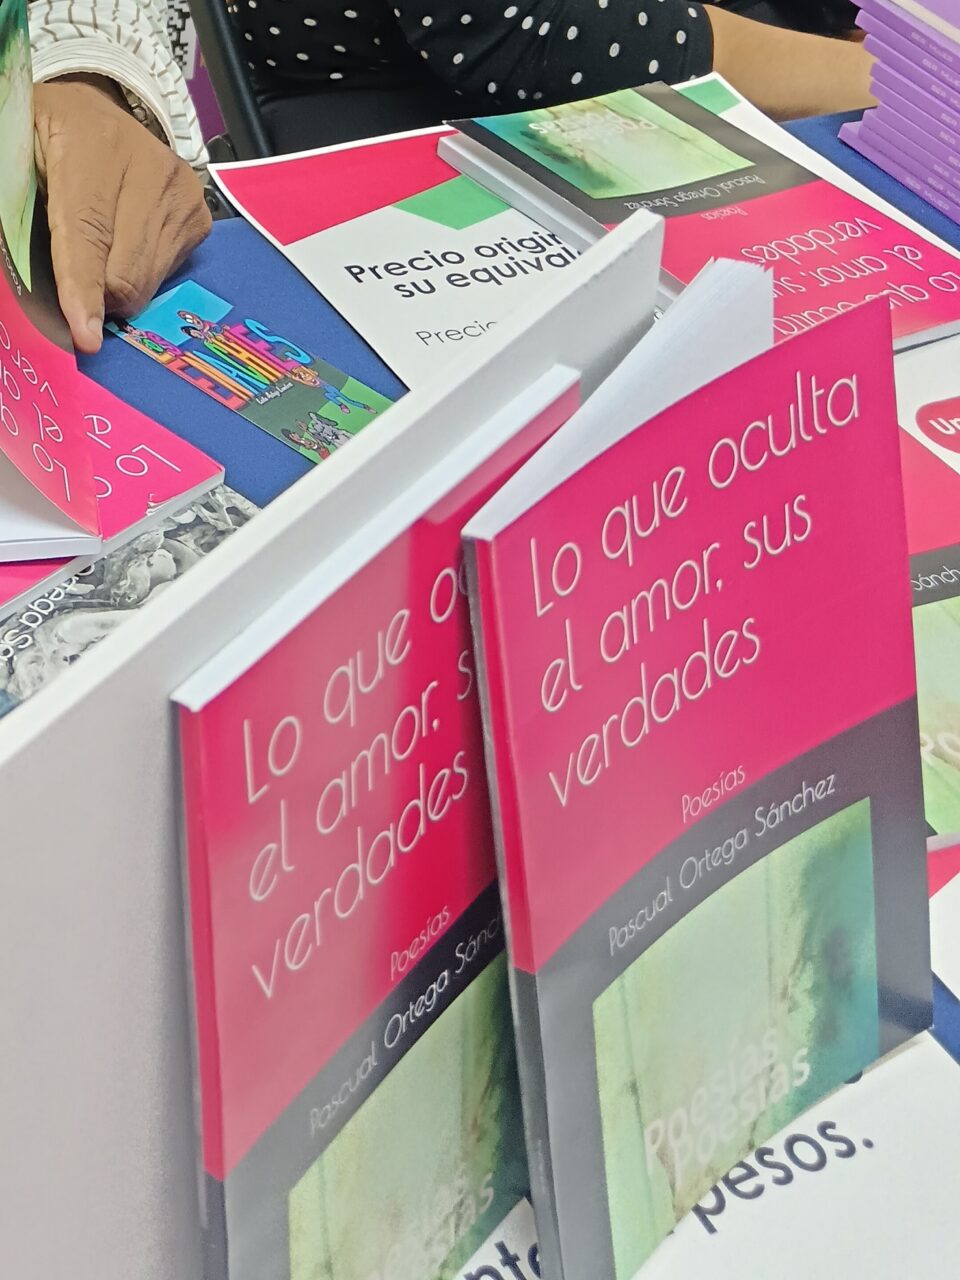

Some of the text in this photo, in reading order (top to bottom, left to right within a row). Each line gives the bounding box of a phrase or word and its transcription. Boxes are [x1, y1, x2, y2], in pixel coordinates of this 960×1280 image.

[343, 248, 465, 284] Precio
[741, 217, 881, 265] verdades
[883, 245, 924, 272] el
[393, 278, 436, 298] su
[33, 402, 65, 444] el
[115, 444, 182, 476] Lo
[33, 442, 71, 502] Lo
[530, 537, 582, 617] Lo
[601, 466, 688, 568] que
[708, 370, 861, 489] oculta
[541, 619, 582, 712] el
[599, 542, 723, 663] amor,
[742, 493, 812, 569] sus
[243, 718, 302, 804] Lo
[323, 609, 412, 727] que
[548, 617, 761, 808] verdades
[681, 765, 746, 824] Poesías
[249, 799, 295, 902] el
[252, 750, 469, 999] verdades
[608, 774, 836, 957] Pascual Ortega Sánchez
[390, 905, 450, 981] Poesías
[310, 1040, 377, 1138] Pascual
[384, 969, 449, 1049] Ortega
